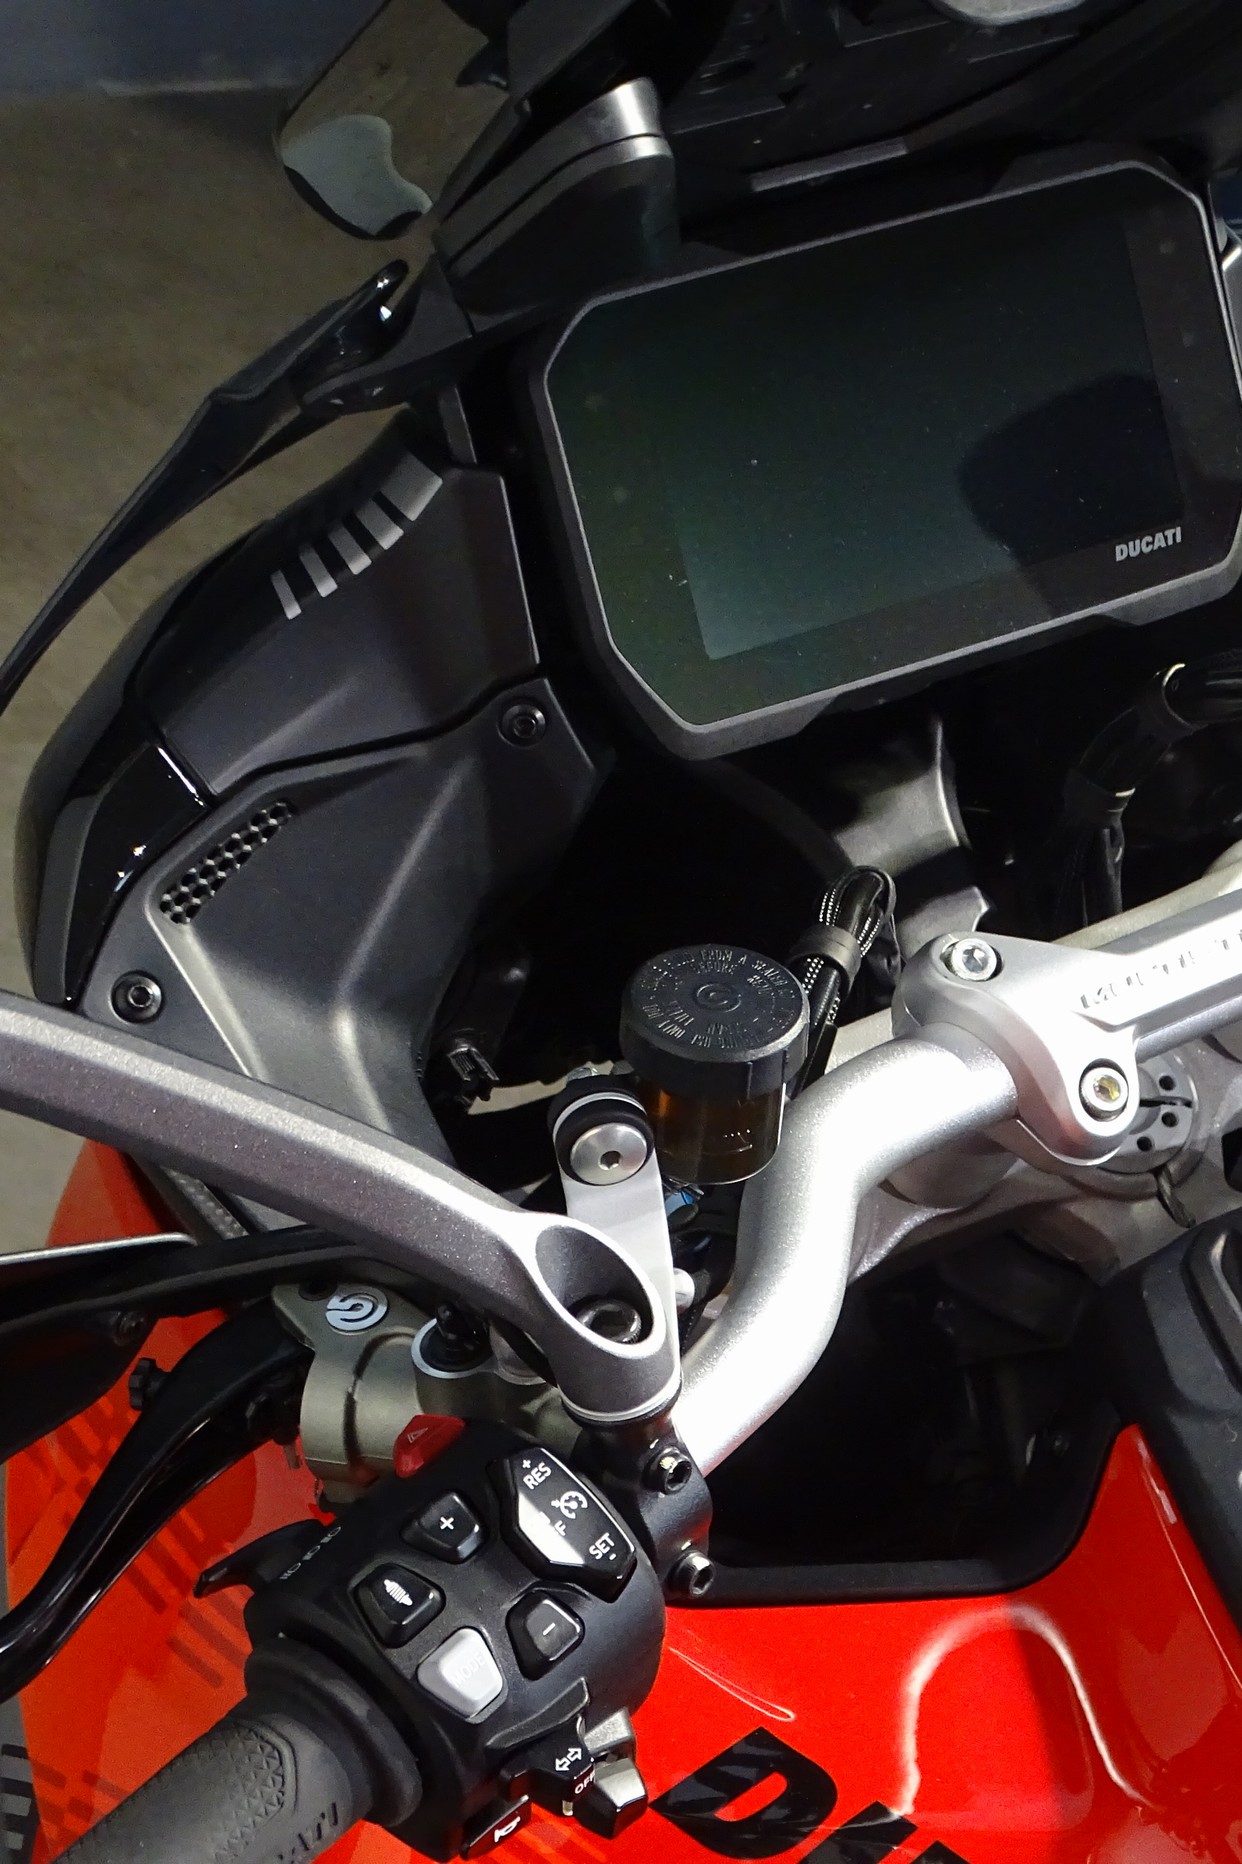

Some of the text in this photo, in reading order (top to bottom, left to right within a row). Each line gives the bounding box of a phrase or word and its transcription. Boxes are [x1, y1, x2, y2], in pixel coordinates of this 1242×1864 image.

[1115, 526, 1182, 562] DUCATI
[523, 1461, 552, 1490] RES
[588, 1532, 615, 1560] SET
